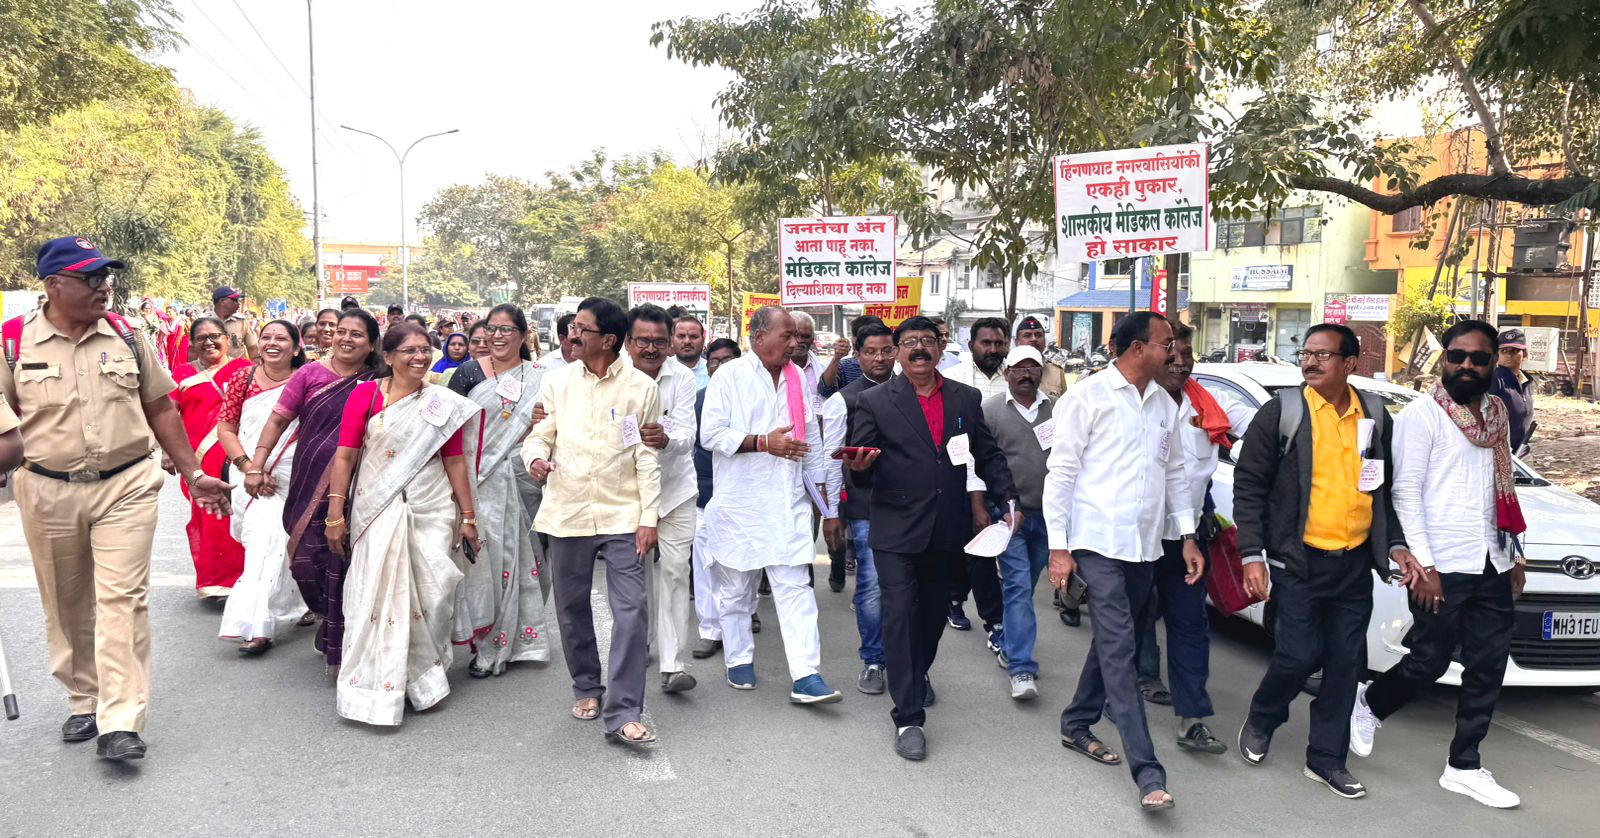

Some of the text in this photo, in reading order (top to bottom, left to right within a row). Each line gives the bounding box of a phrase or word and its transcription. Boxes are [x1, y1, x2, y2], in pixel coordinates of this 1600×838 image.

[1060, 149, 1201, 181] हिंगणघाट नगरवासियोंकी
[1085, 176, 1130, 200] एकही
[784, 218, 886, 235] जनतेचा अंत
[1062, 198, 1203, 239] शासकीय मेडिकल कॉलेज
[794, 239, 823, 252] आता
[826, 239, 847, 258] पाहू
[1085, 236, 1178, 259] हो साकार
[785, 254, 892, 278] मेडिकल कॉलेज
[672, 287, 707, 302] शासकीय
[786, 280, 844, 299] दिल्याशिवाय
[846, 283, 867, 300] राहू
[866, 282, 887, 295] नका
